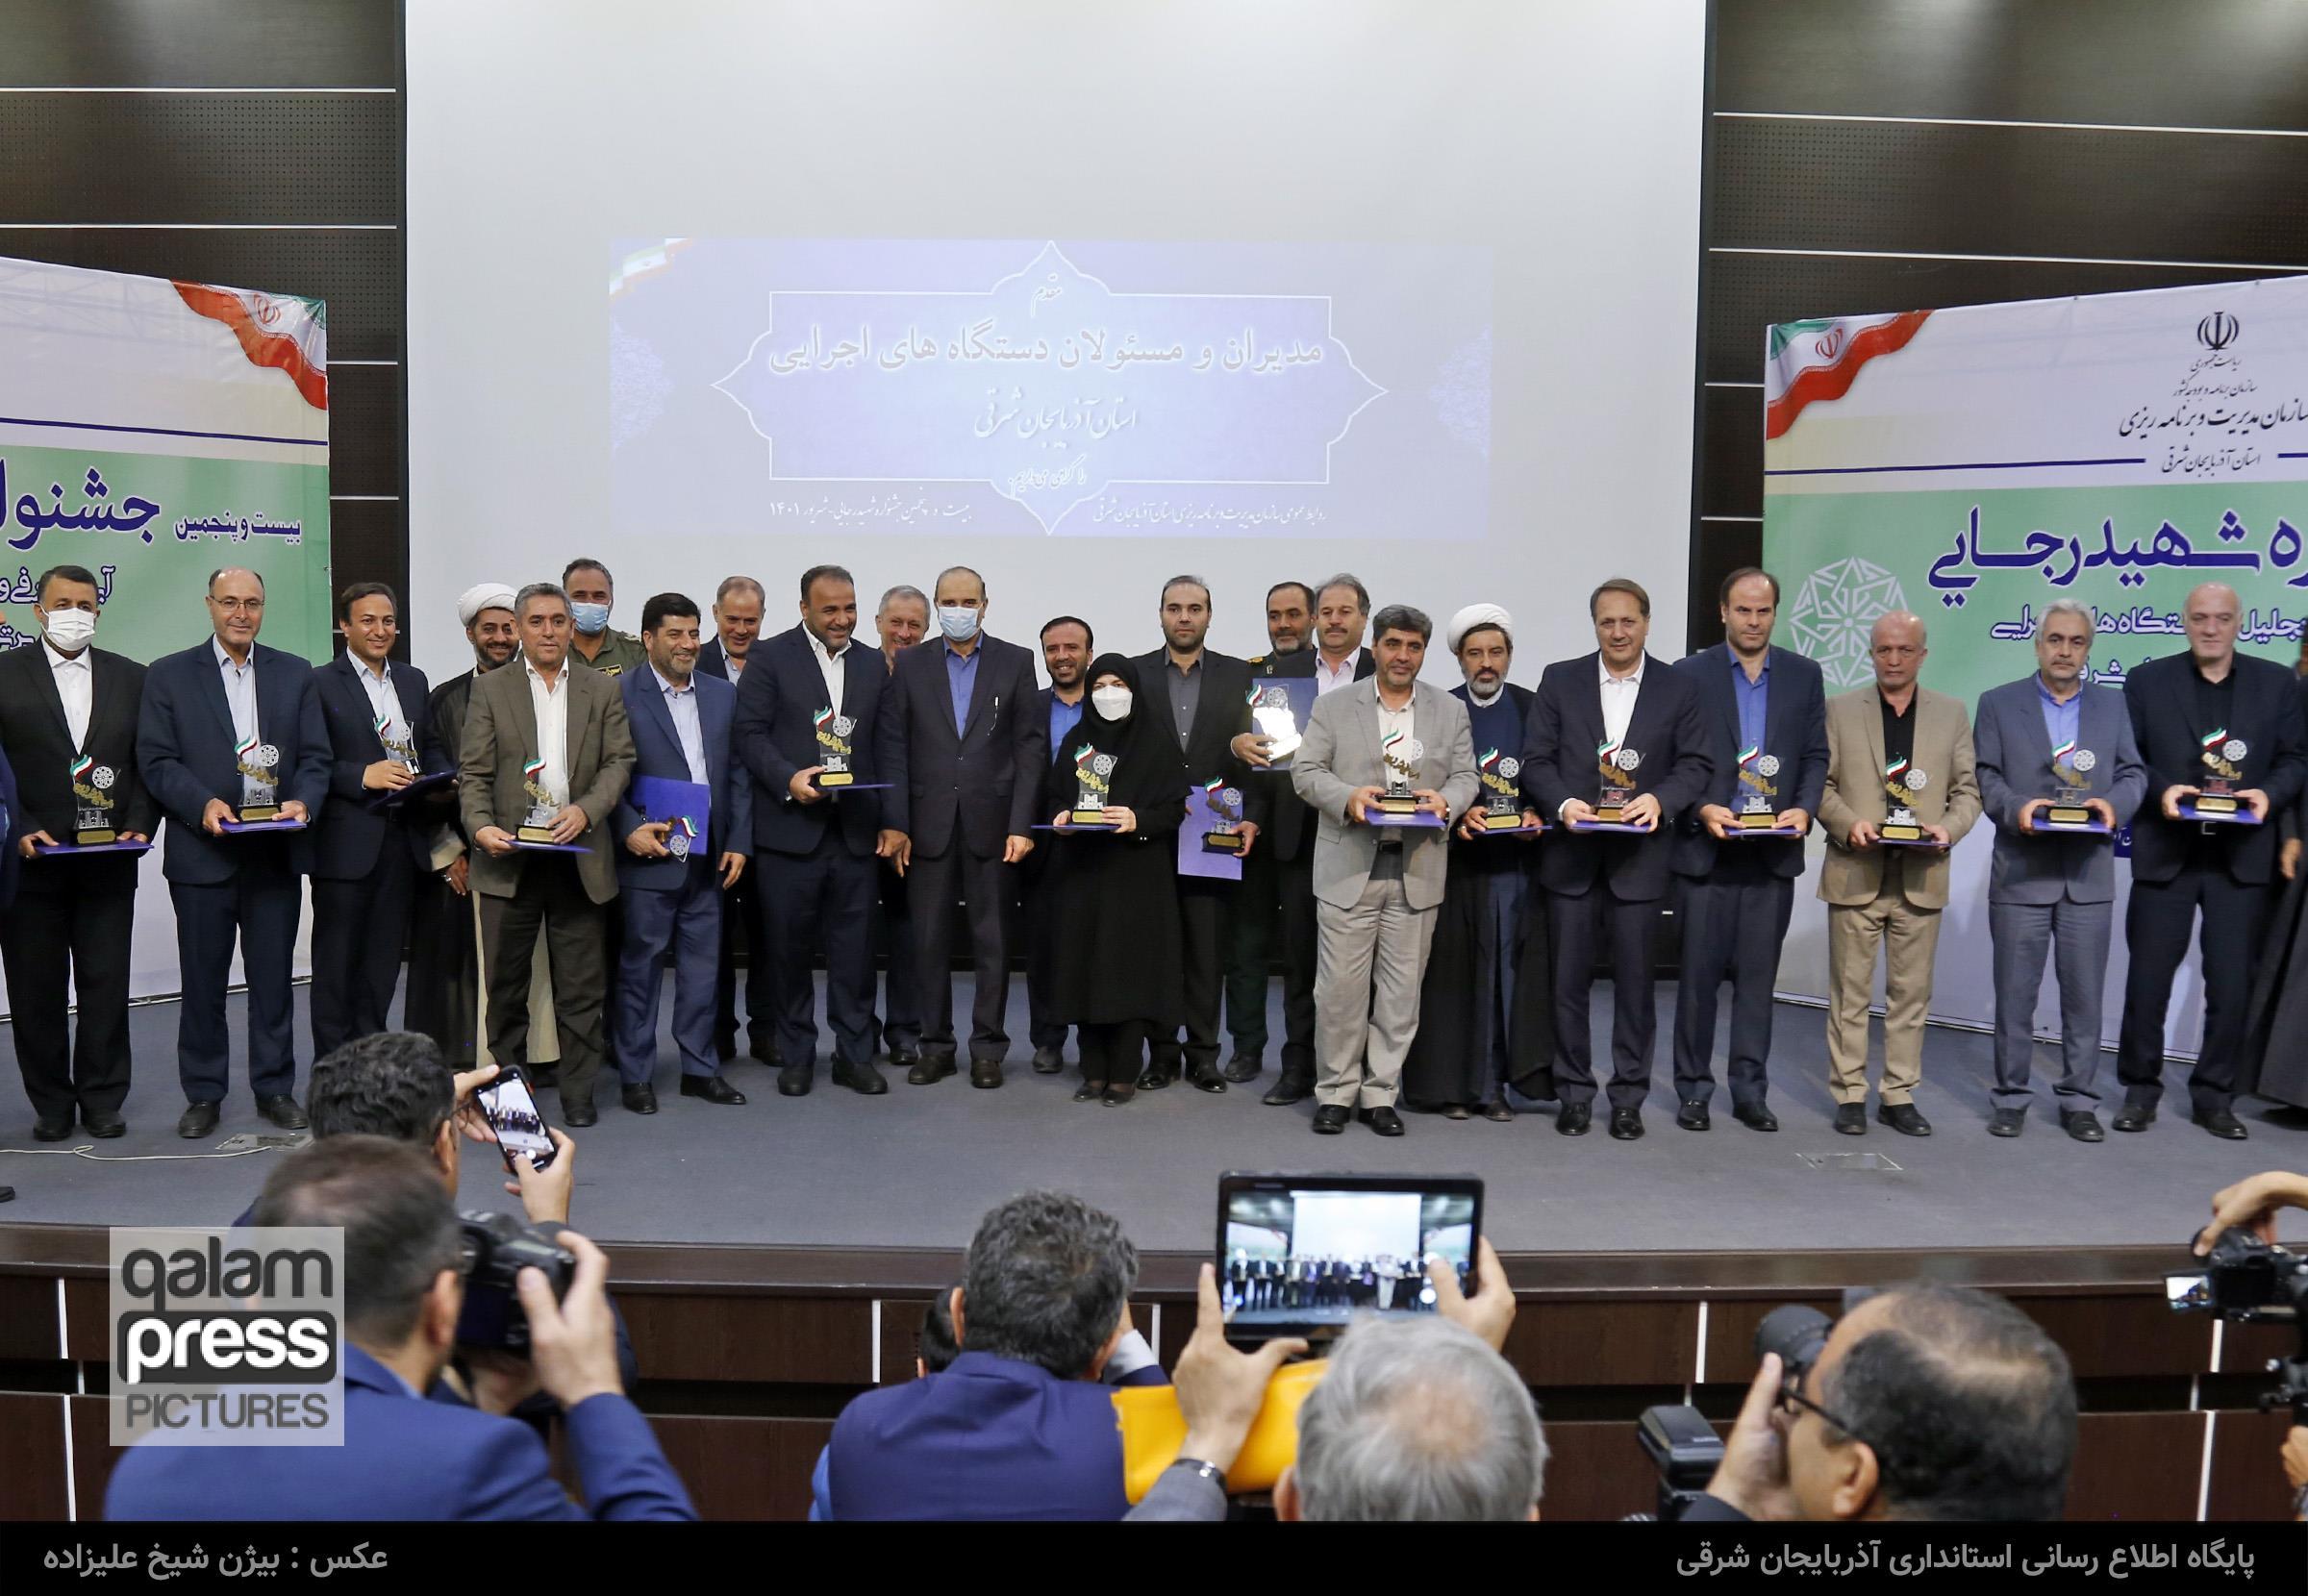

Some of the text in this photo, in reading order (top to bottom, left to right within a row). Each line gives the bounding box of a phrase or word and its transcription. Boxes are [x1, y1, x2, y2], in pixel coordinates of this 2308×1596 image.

[1030, 273, 1062, 318] مقدم
[770, 318, 1323, 374] مدیران و مسئولان دستگاه های اجرایی
[2214, 356, 2242, 372] ریاست
[2229, 379, 2259, 398] سازمان
[974, 386, 1137, 449] استان آذربایجان شرقی
[2119, 397, 2308, 439] ازمان مدیریت و برنامه ریزی
[2161, 443, 2261, 478] استان آذربایجان شرقی
[174, 510, 301, 544] بیست و پنجمین
[770, 501, 799, 516] ۱۴۰۱
[1927, 504, 2084, 608] رجایی
[2082, 509, 2261, 588] شهید
